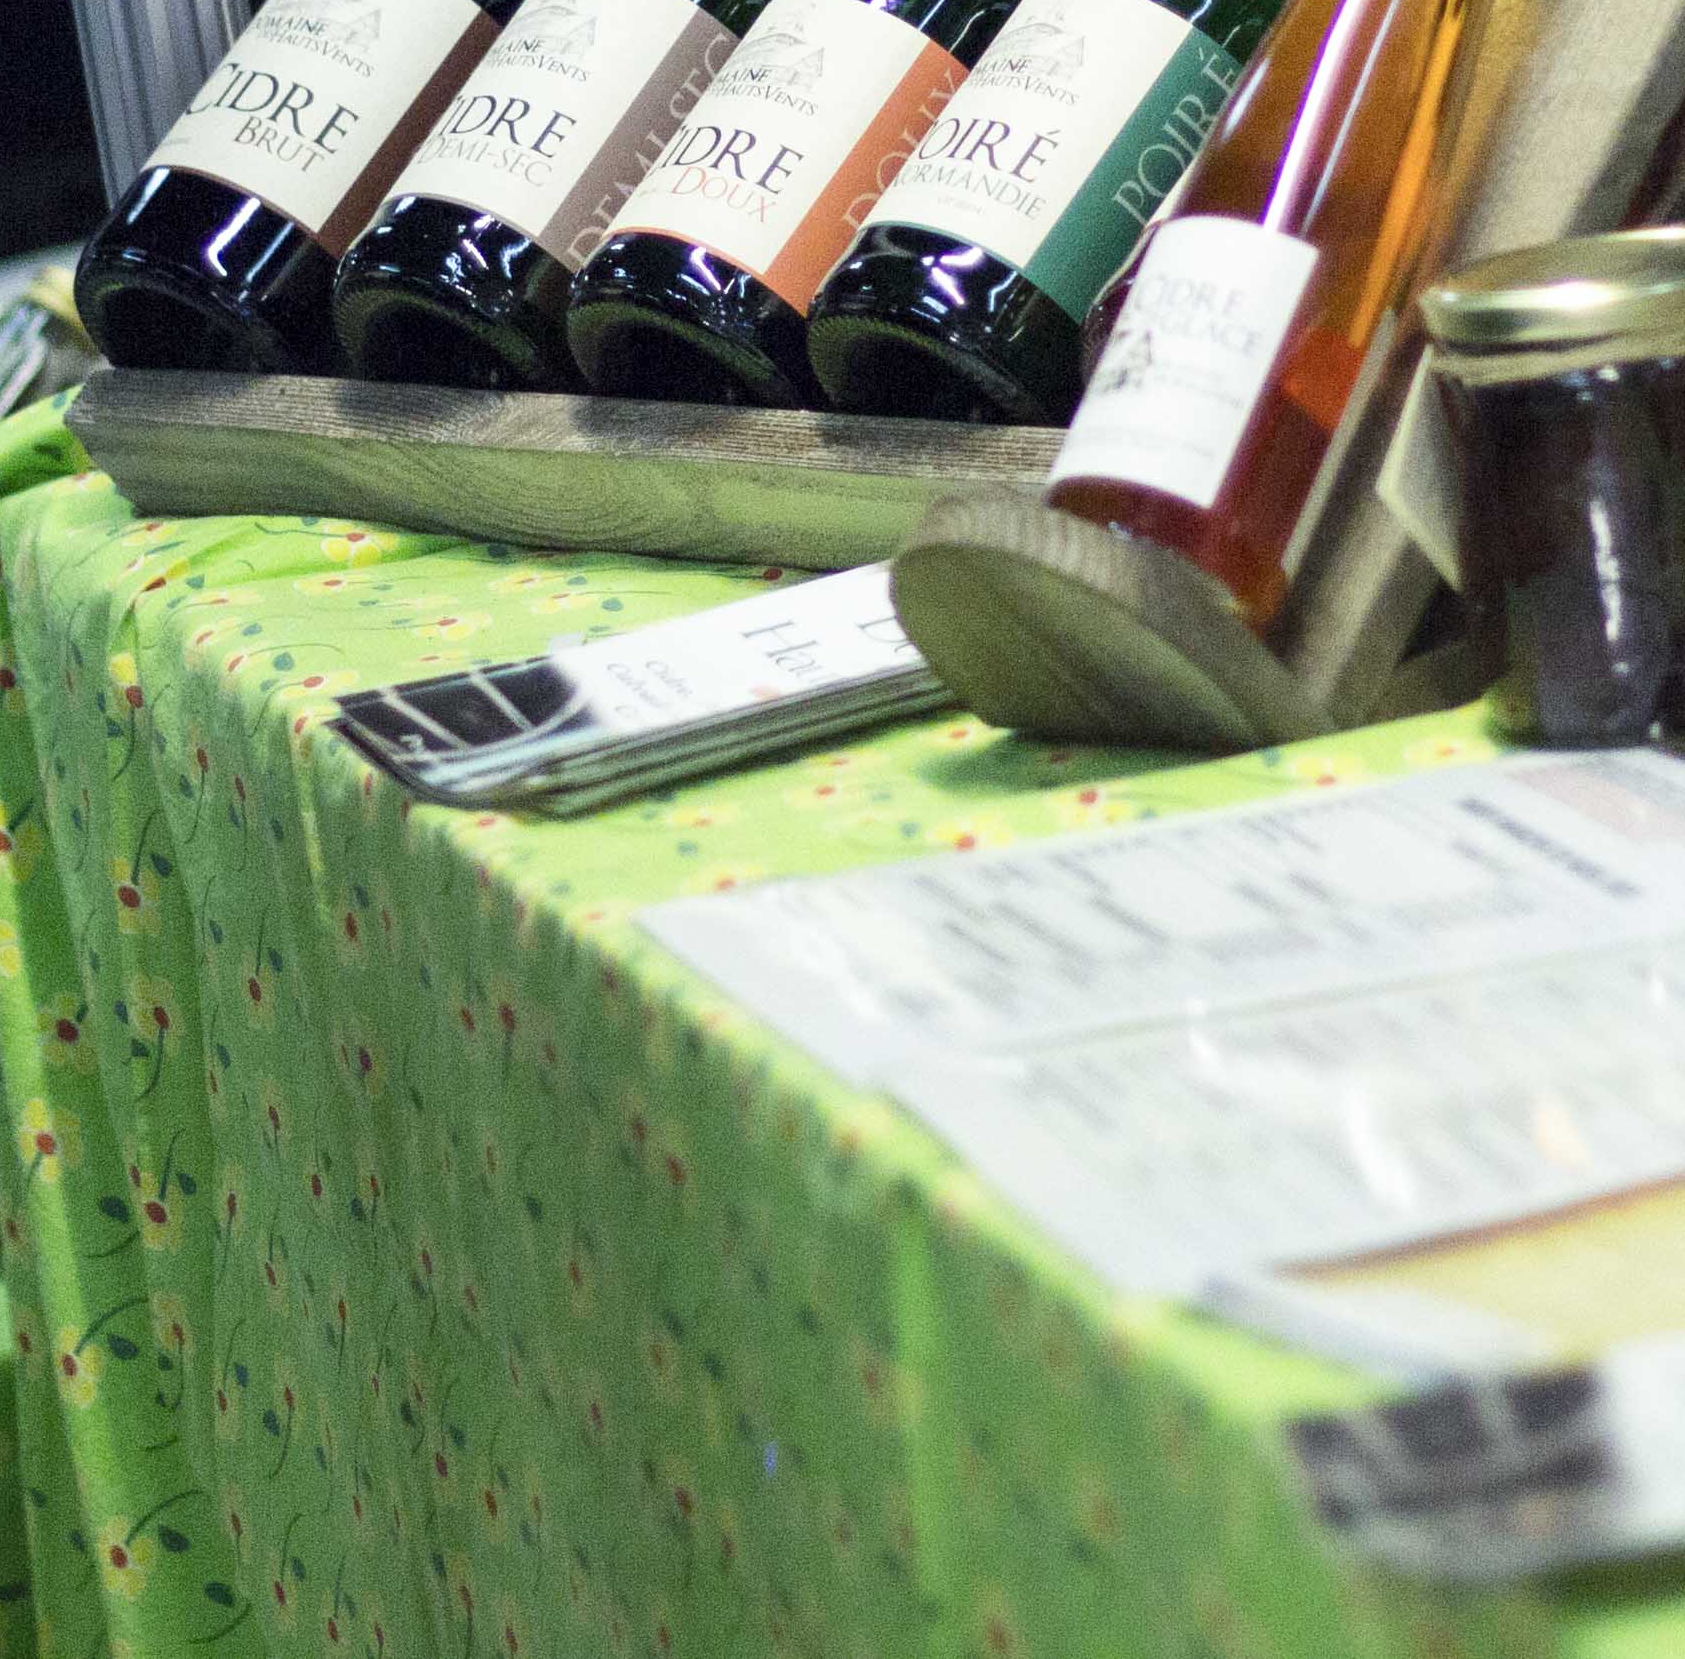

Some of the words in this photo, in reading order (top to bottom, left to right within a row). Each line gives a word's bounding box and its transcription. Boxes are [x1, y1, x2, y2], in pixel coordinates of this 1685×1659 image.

[234, 116, 325, 172] BRUT
[438, 94, 577, 158] IDRE
[918, 118, 1061, 184] OIRÉ
[1111, 45, 1238, 226] POIRÉ
[660, 125, 805, 194] IDRE
[671, 166, 777, 222] DOUX
